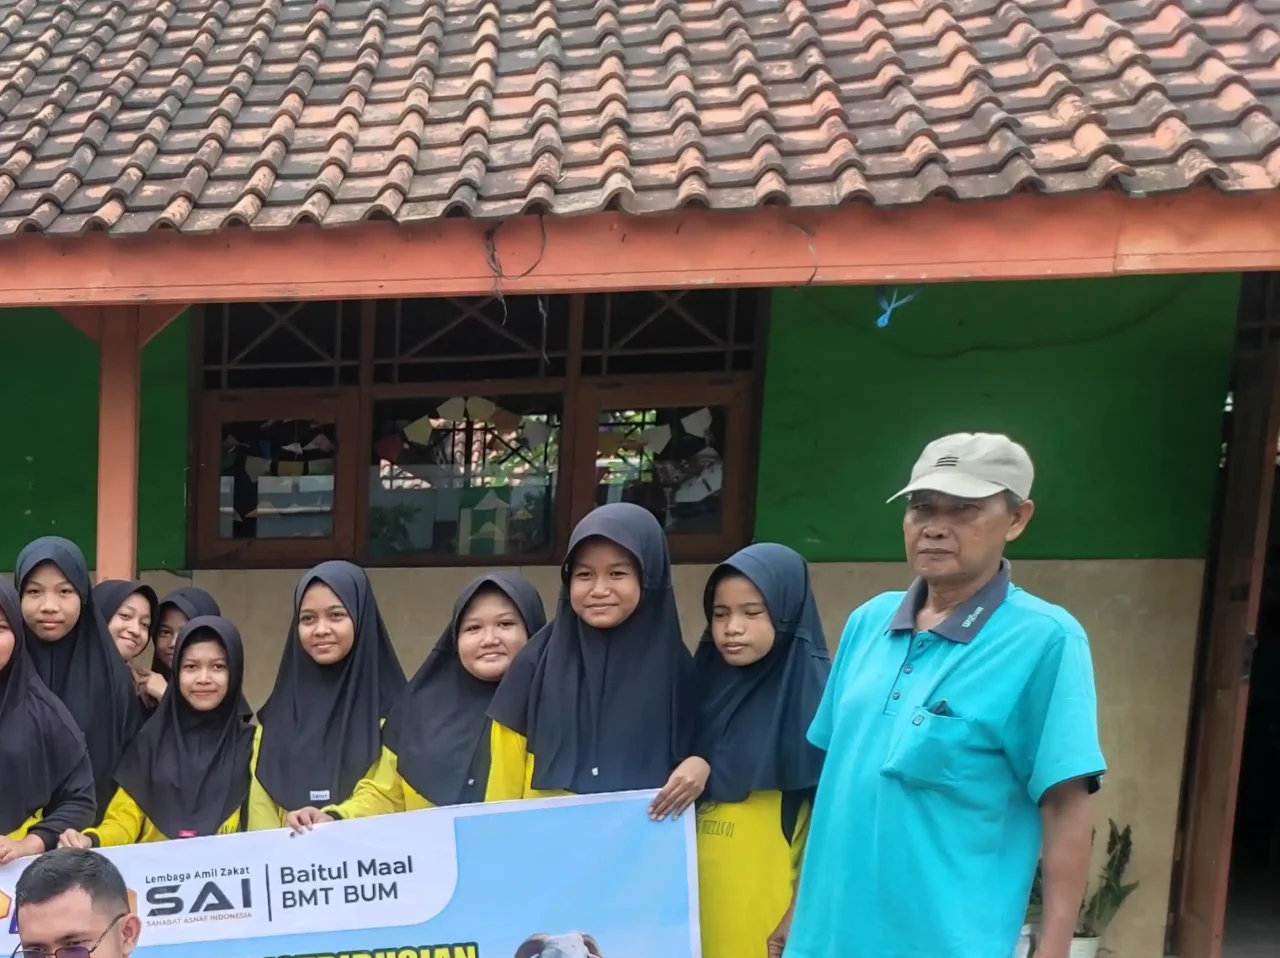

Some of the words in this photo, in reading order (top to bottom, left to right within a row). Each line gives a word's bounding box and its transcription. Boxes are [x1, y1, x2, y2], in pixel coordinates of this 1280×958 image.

[145, 872, 191, 884] Lembaga
[194, 868, 218, 880] Amil
[220, 866, 251, 877] Zakat
[280, 860, 349, 885] Baitul
[357, 855, 414, 878] Maal
[146, 878, 253, 917] SAI
[282, 887, 334, 909] BMT
[344, 881, 399, 904] BUM
[146, 918, 182, 927] SAHABAT
[183, 915, 209, 924] ASNAF
[210, 912, 253, 922] INDONESIA
